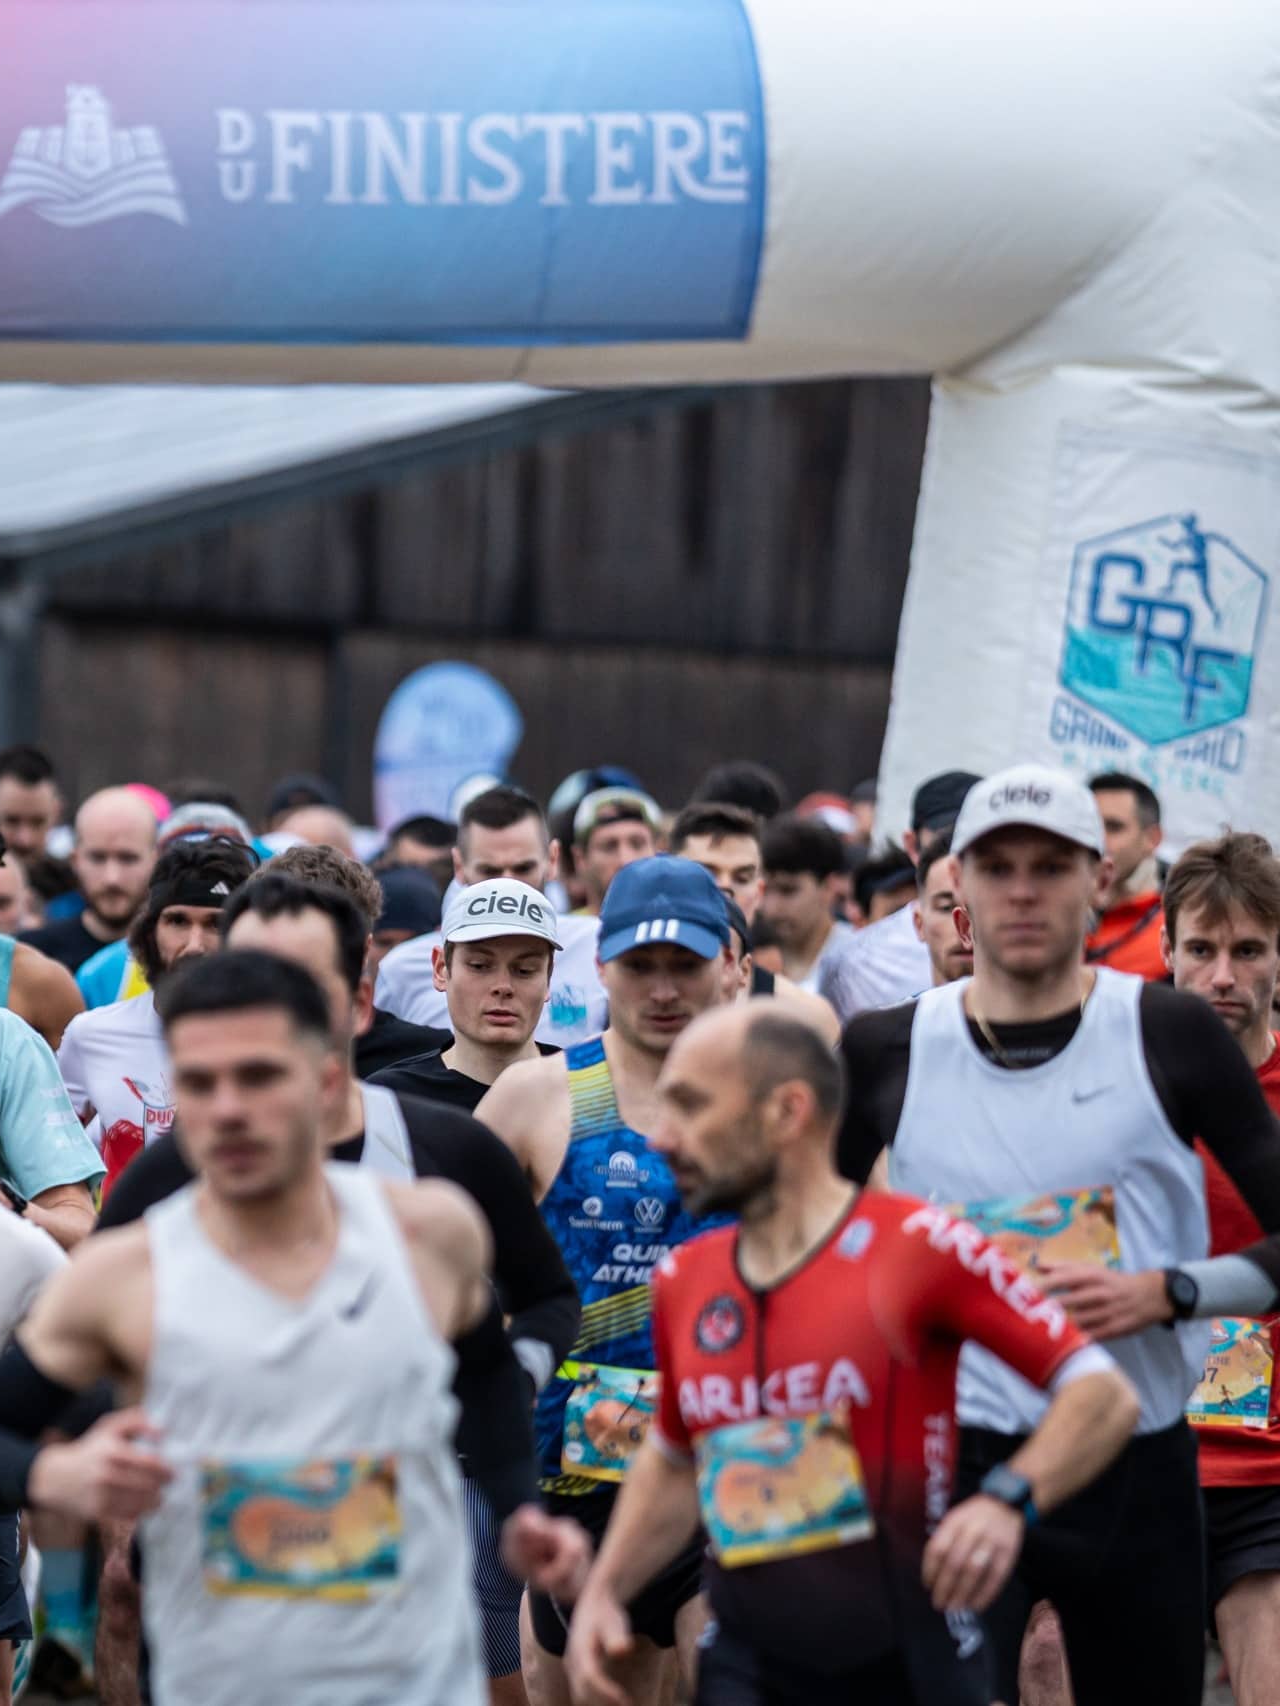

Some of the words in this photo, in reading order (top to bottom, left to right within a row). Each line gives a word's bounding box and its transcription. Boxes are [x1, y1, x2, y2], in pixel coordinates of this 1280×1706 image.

[266, 109, 750, 206] FINISTERE
[1088, 552, 1237, 722] GRF
[468, 891, 543, 923] ciele
